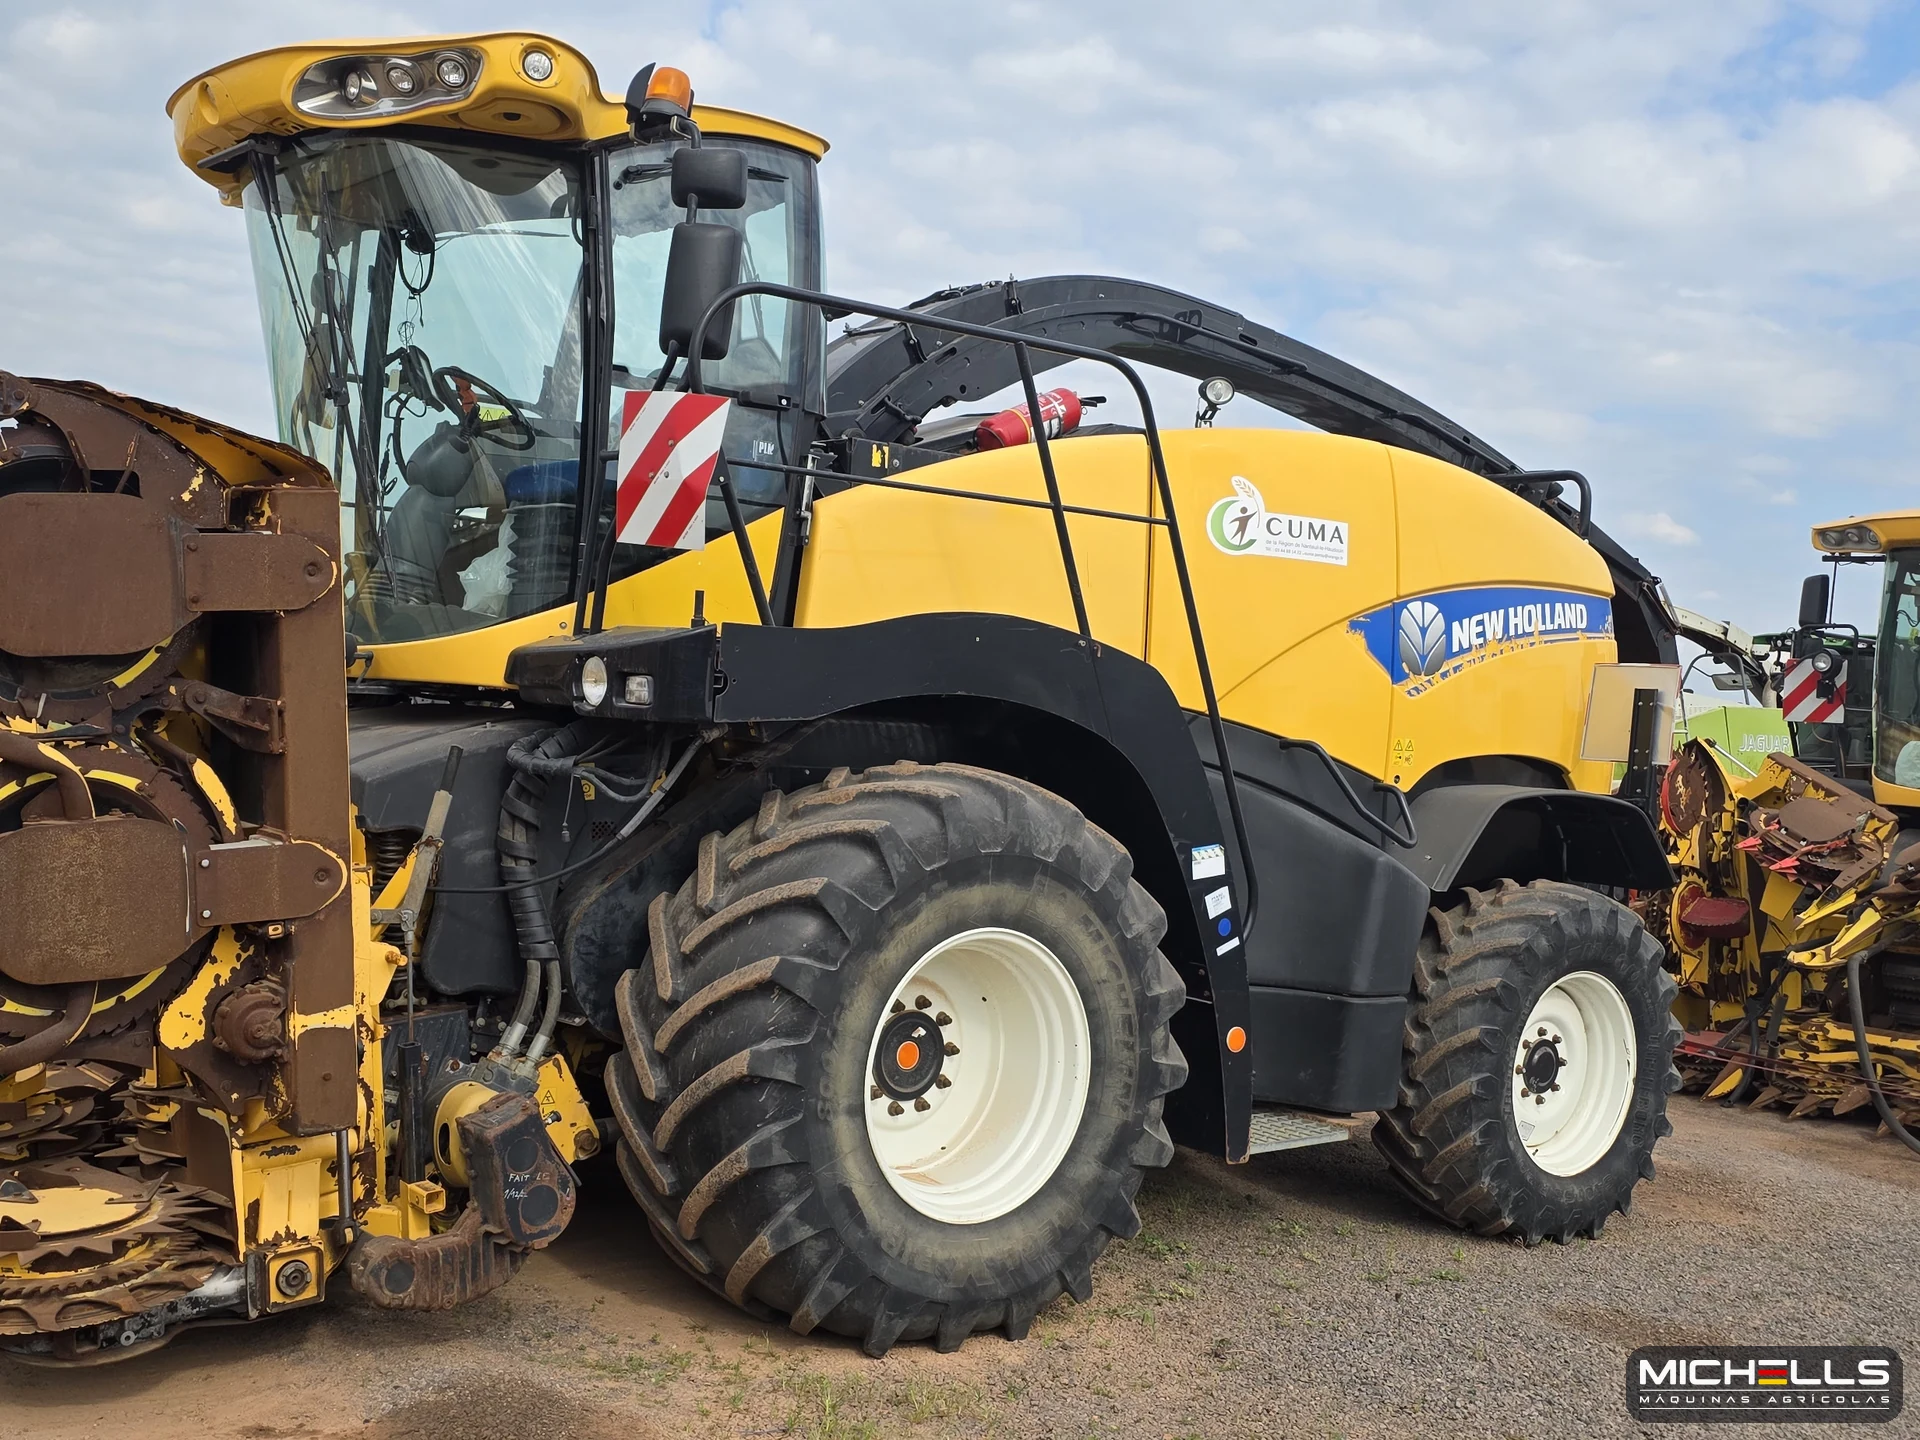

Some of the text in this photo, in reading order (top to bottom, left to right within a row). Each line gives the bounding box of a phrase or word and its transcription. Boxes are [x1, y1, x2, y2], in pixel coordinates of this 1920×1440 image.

[1265, 517, 1344, 545] CUMA
[1452, 603, 1588, 653] NEW HOLLAND
[1739, 733, 1791, 753] JAGUAR
